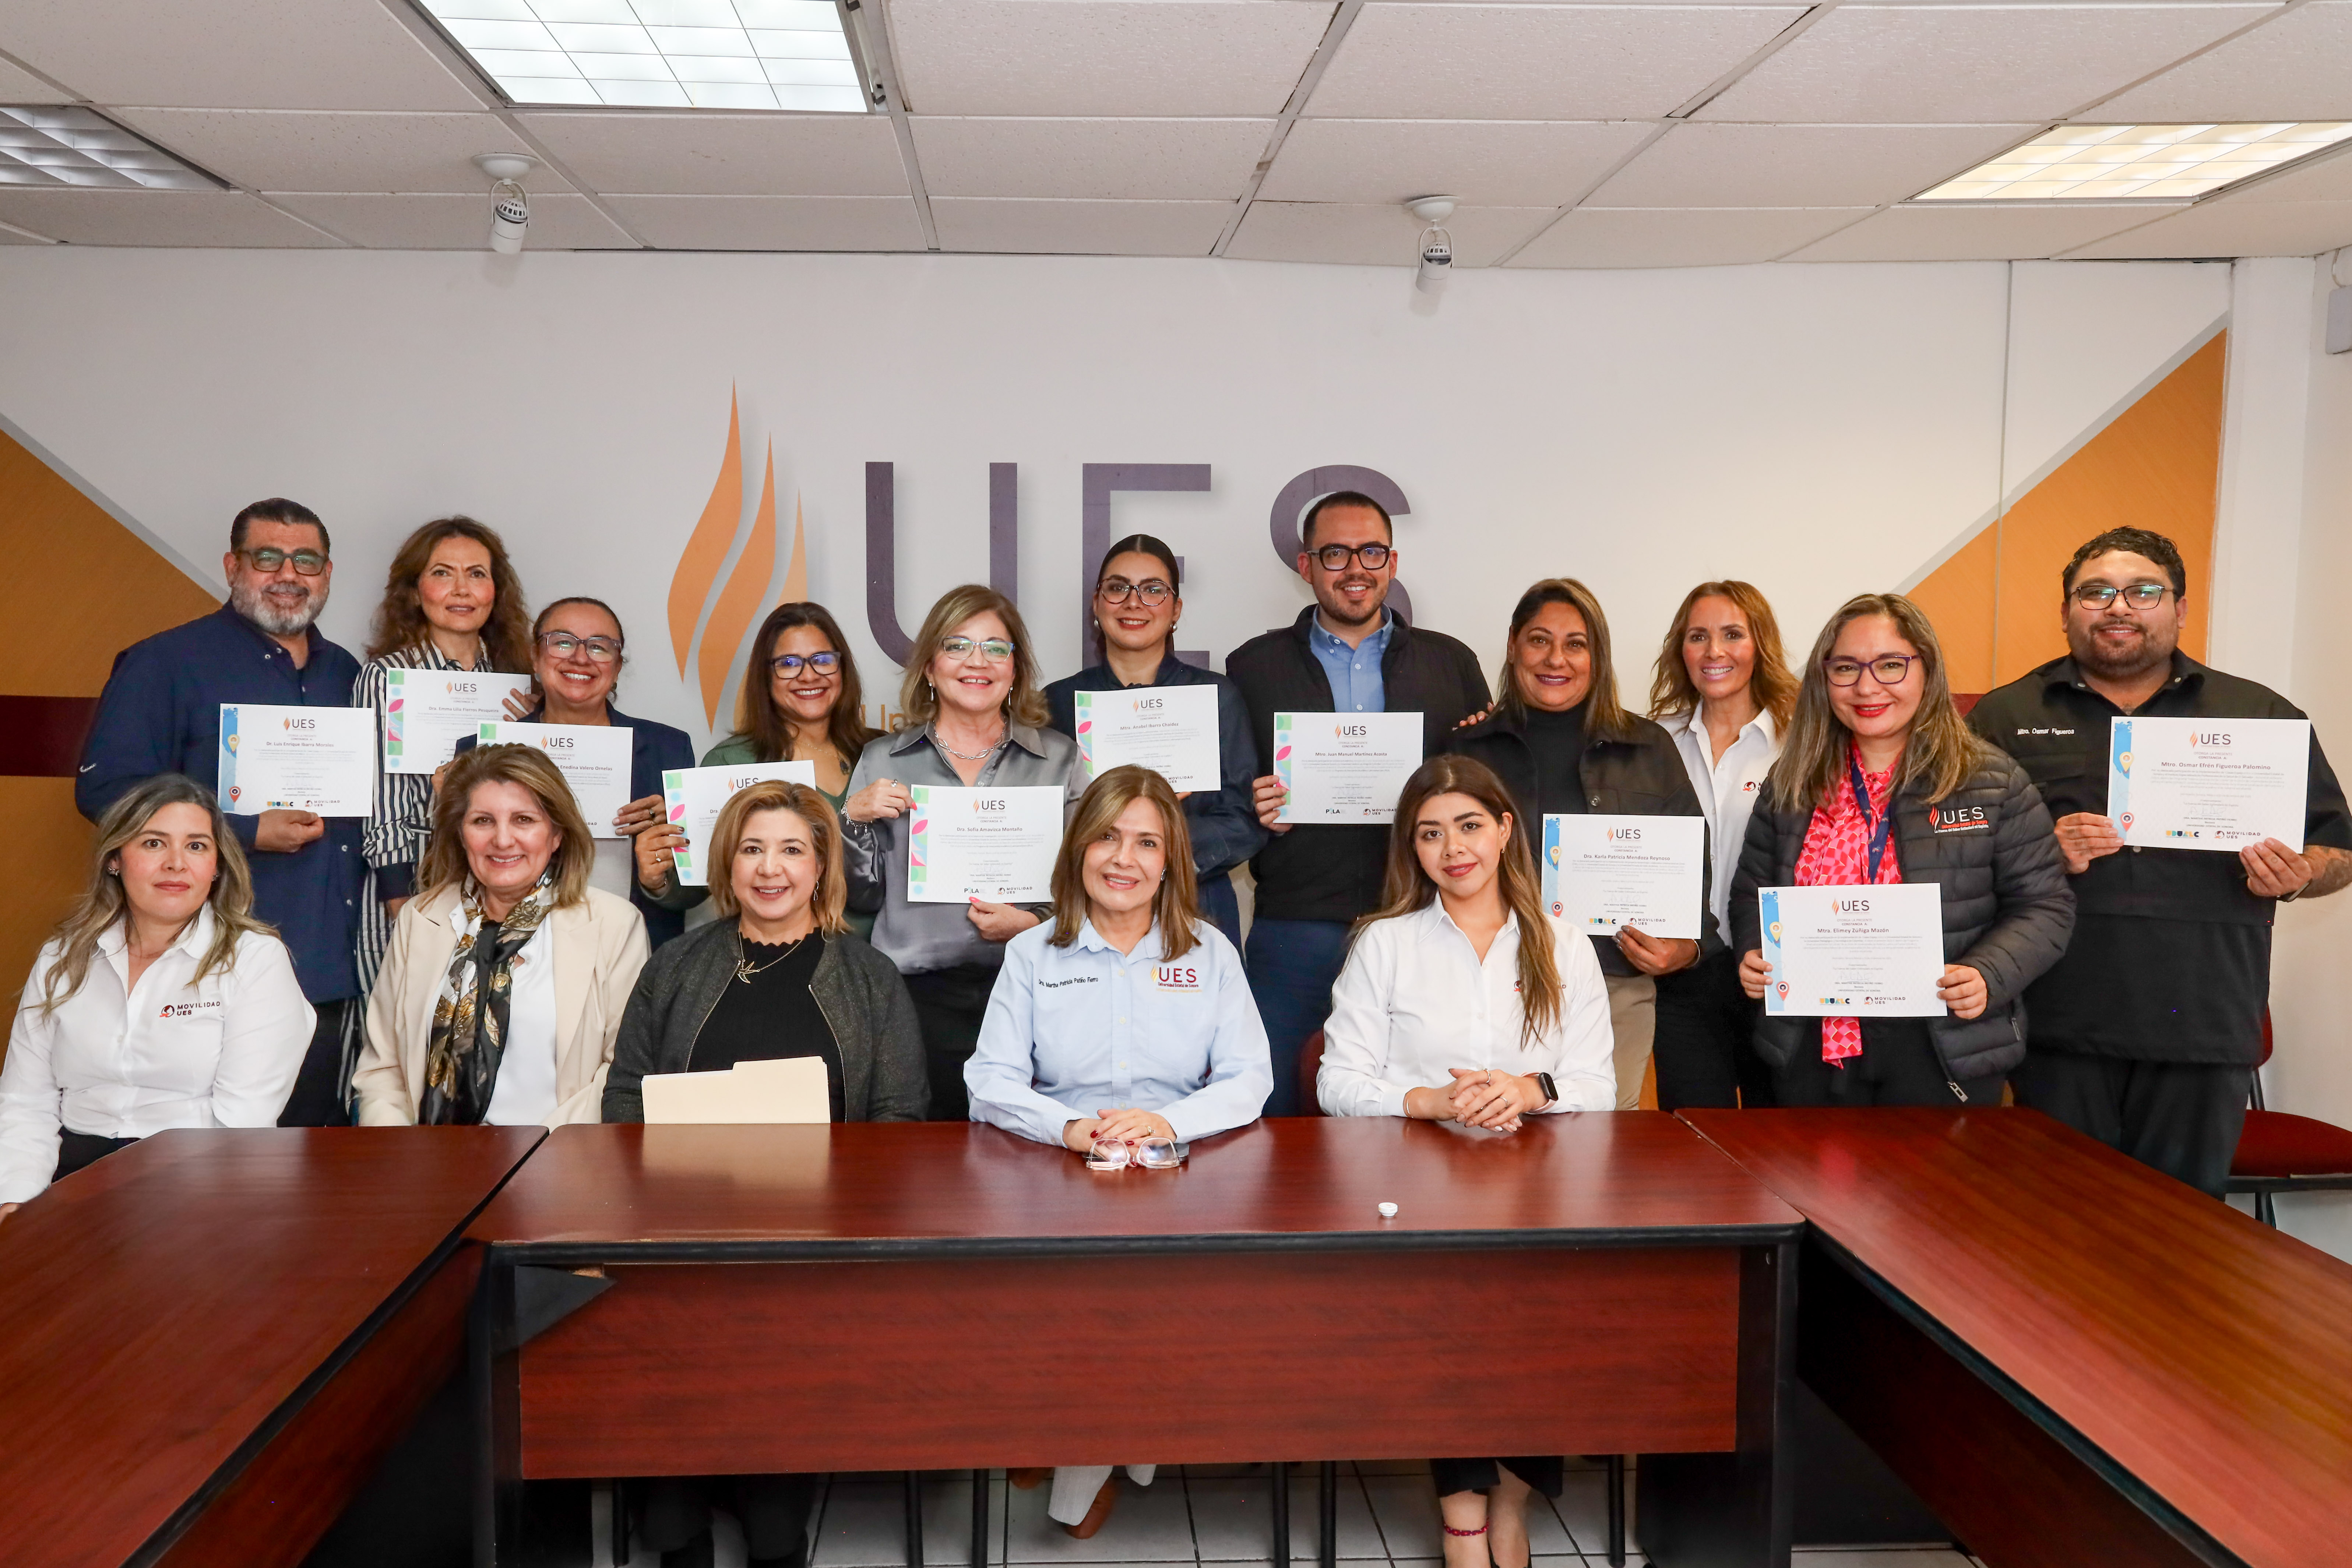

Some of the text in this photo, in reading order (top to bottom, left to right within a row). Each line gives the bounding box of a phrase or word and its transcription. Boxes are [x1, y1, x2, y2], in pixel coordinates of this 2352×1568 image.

[455, 683, 476, 692] UES
[1141, 699, 1163, 708] UES
[292, 719, 315, 728] UES
[1344, 726, 1366, 735] UES
[550, 738, 573, 747] UES
[2201, 734, 2231, 744] UES
[982, 800, 1005, 810] UES
[1943, 807, 1984, 824] UES
[1616, 829, 1641, 839] UES
[1842, 901, 1869, 911] UES
[1159, 967, 1197, 983] UES
[177, 1001, 221, 1009] MOVILIDAD
